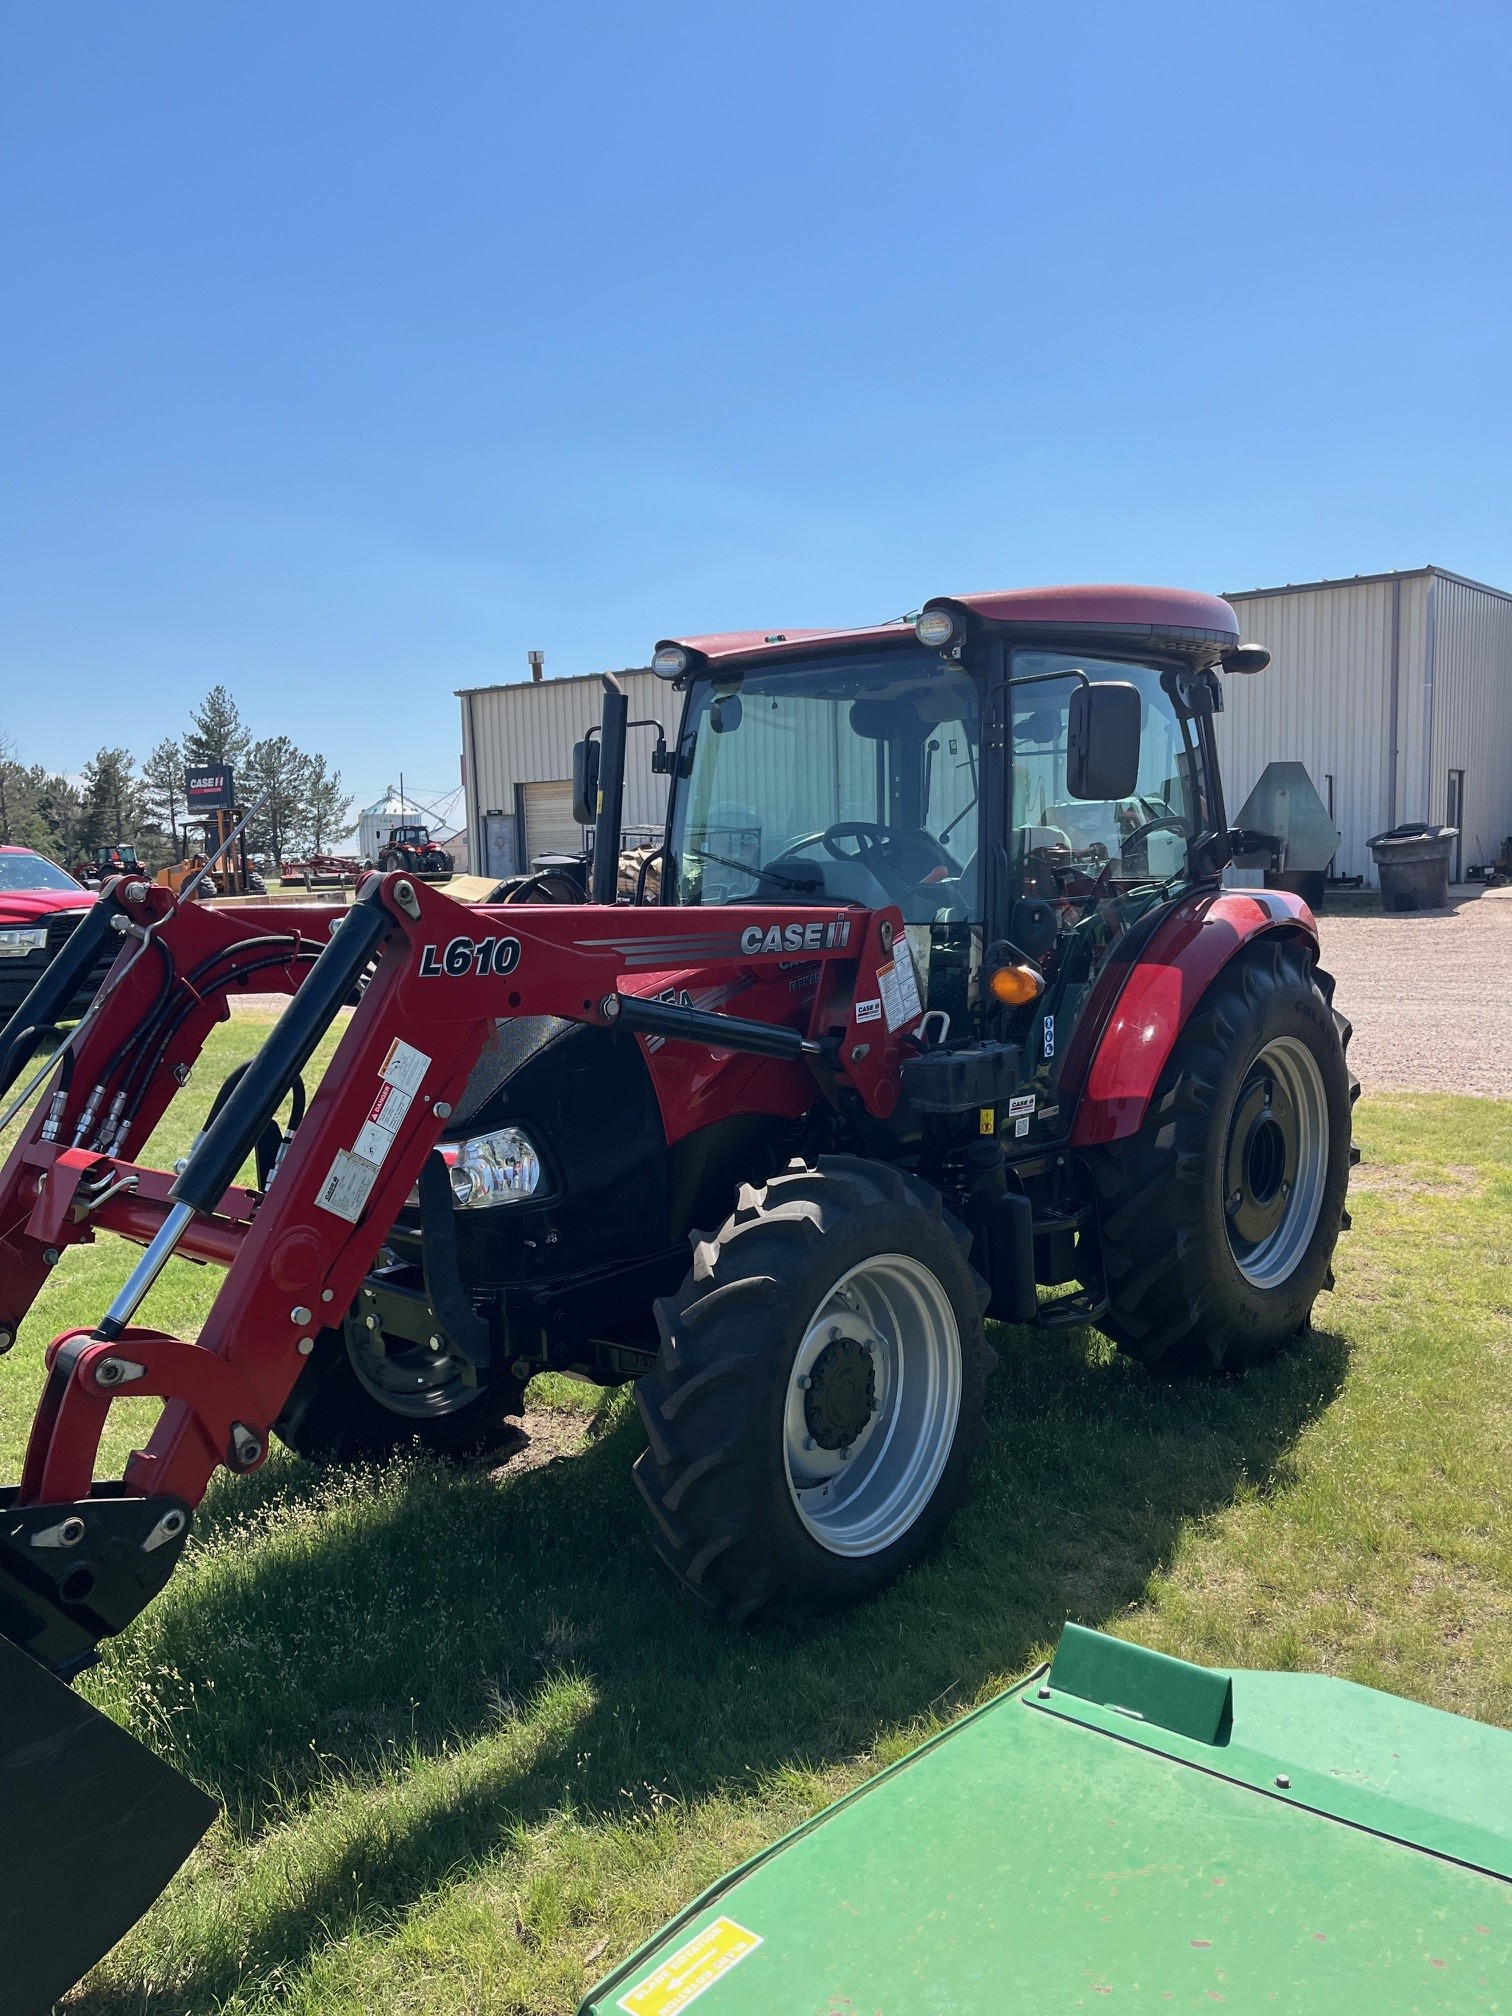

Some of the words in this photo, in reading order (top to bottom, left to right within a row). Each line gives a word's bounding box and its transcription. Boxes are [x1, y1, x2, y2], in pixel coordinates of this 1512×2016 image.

[190, 777, 214, 788] CASE
[741, 922, 824, 955] CASE
[419, 936, 522, 977] L610
[857, 1004, 874, 1013] CASE
[374, 1085, 391, 1113] DANGER
[1011, 1099, 1029, 1108] CASE
[633, 1969, 671, 2001] BLADE
[670, 1926, 723, 1971] ROTATION
